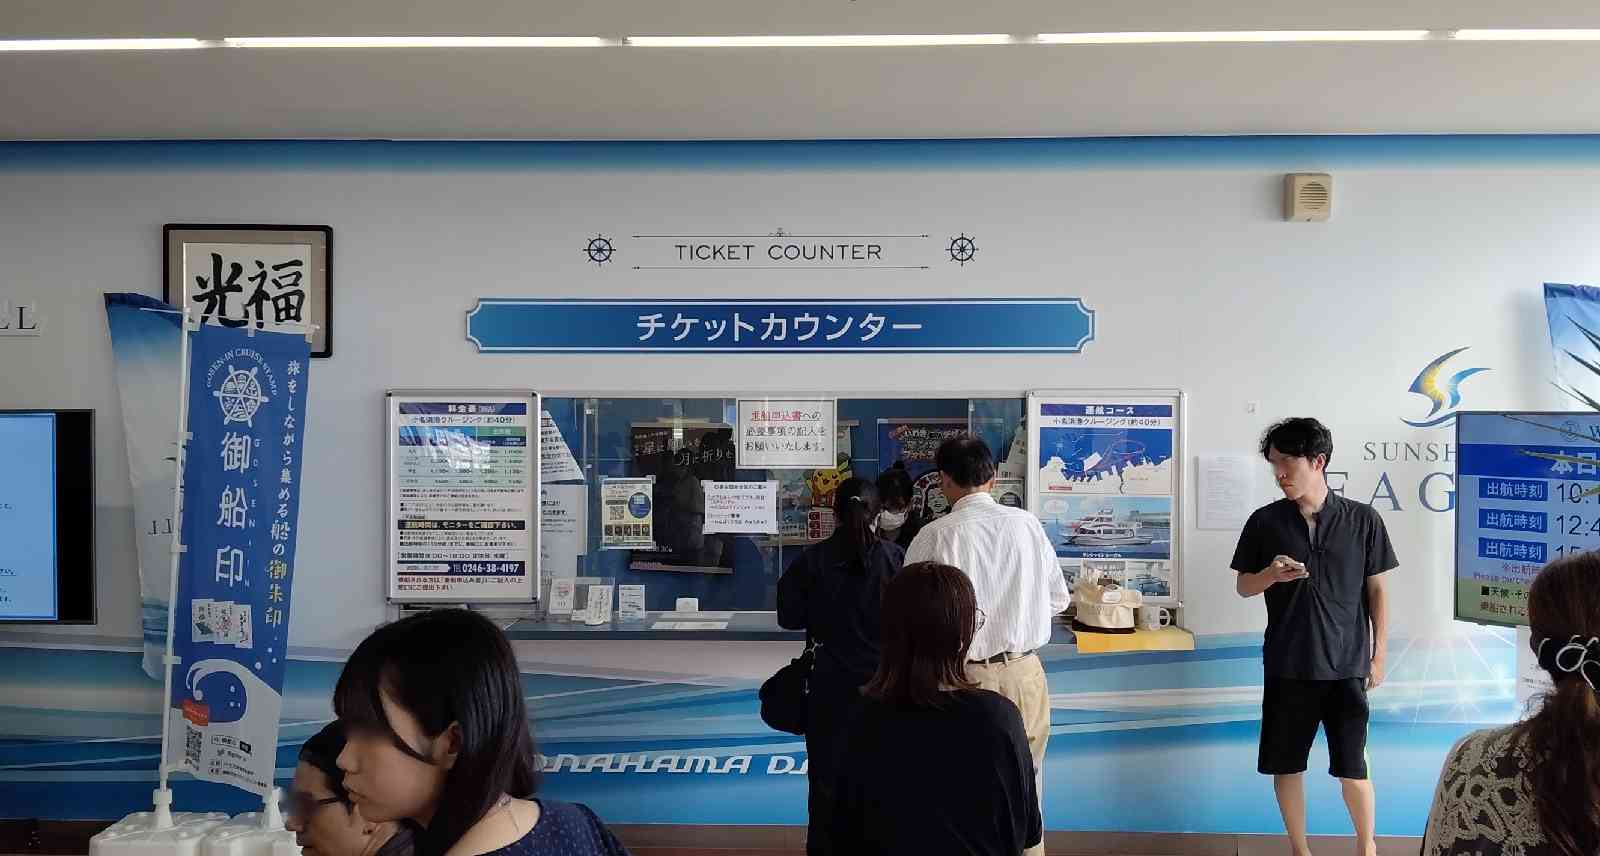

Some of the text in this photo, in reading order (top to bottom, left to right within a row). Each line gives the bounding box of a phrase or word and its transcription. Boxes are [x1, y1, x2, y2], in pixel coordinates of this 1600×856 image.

[675, 244, 882, 261] TICKET COUNTER
[636, 312, 924, 342] チケットカウンター
[1487, 482, 1543, 498] 出航時刻
[214, 431, 252, 588] 御船印
[1486, 512, 1542, 530] 出航時刻
[1486, 541, 1542, 561] 出航時刻
[462, 563, 519, 573] 0246-38-4197
